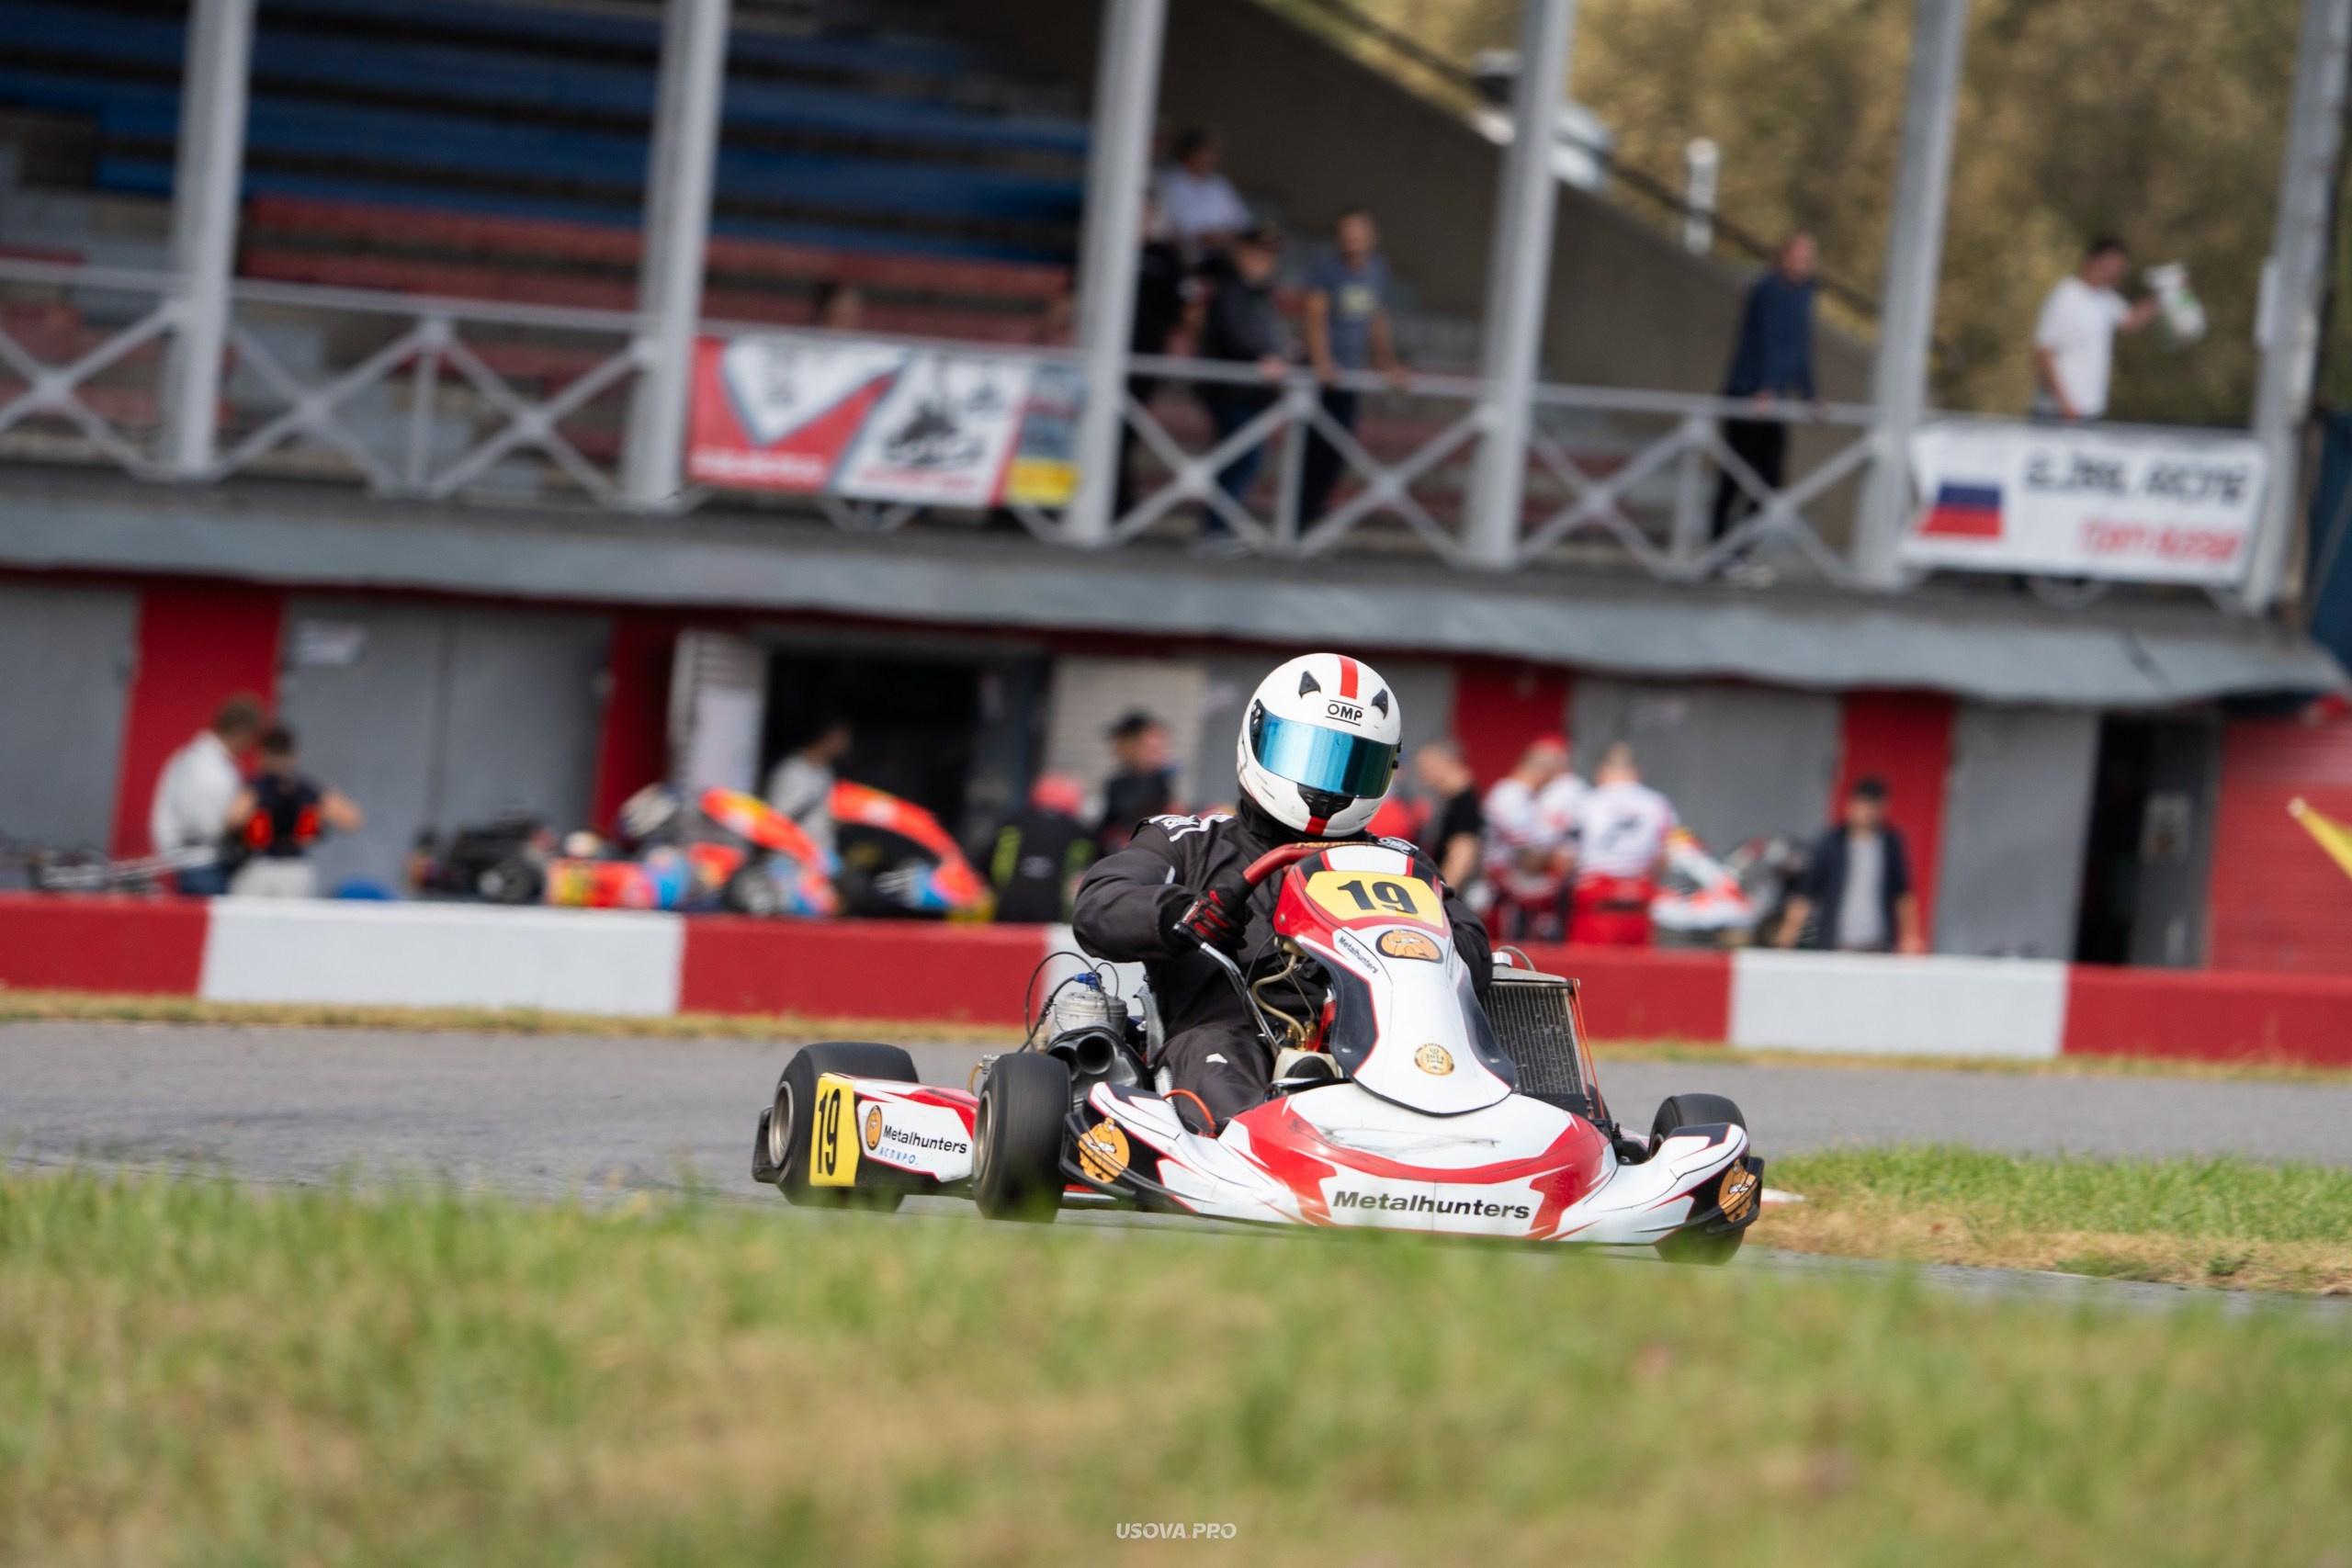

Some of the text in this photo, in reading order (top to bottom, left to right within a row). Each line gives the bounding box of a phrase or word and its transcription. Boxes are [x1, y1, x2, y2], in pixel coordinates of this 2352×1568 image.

[1328, 703, 1363, 721] OMP
[1337, 880, 1419, 915] 19
[1338, 936, 1379, 974] Metalhunters
[817, 1088, 842, 1177] 19
[883, 1124, 968, 1155] Metalhunters
[1332, 1190, 1531, 1220] Metalhunters
